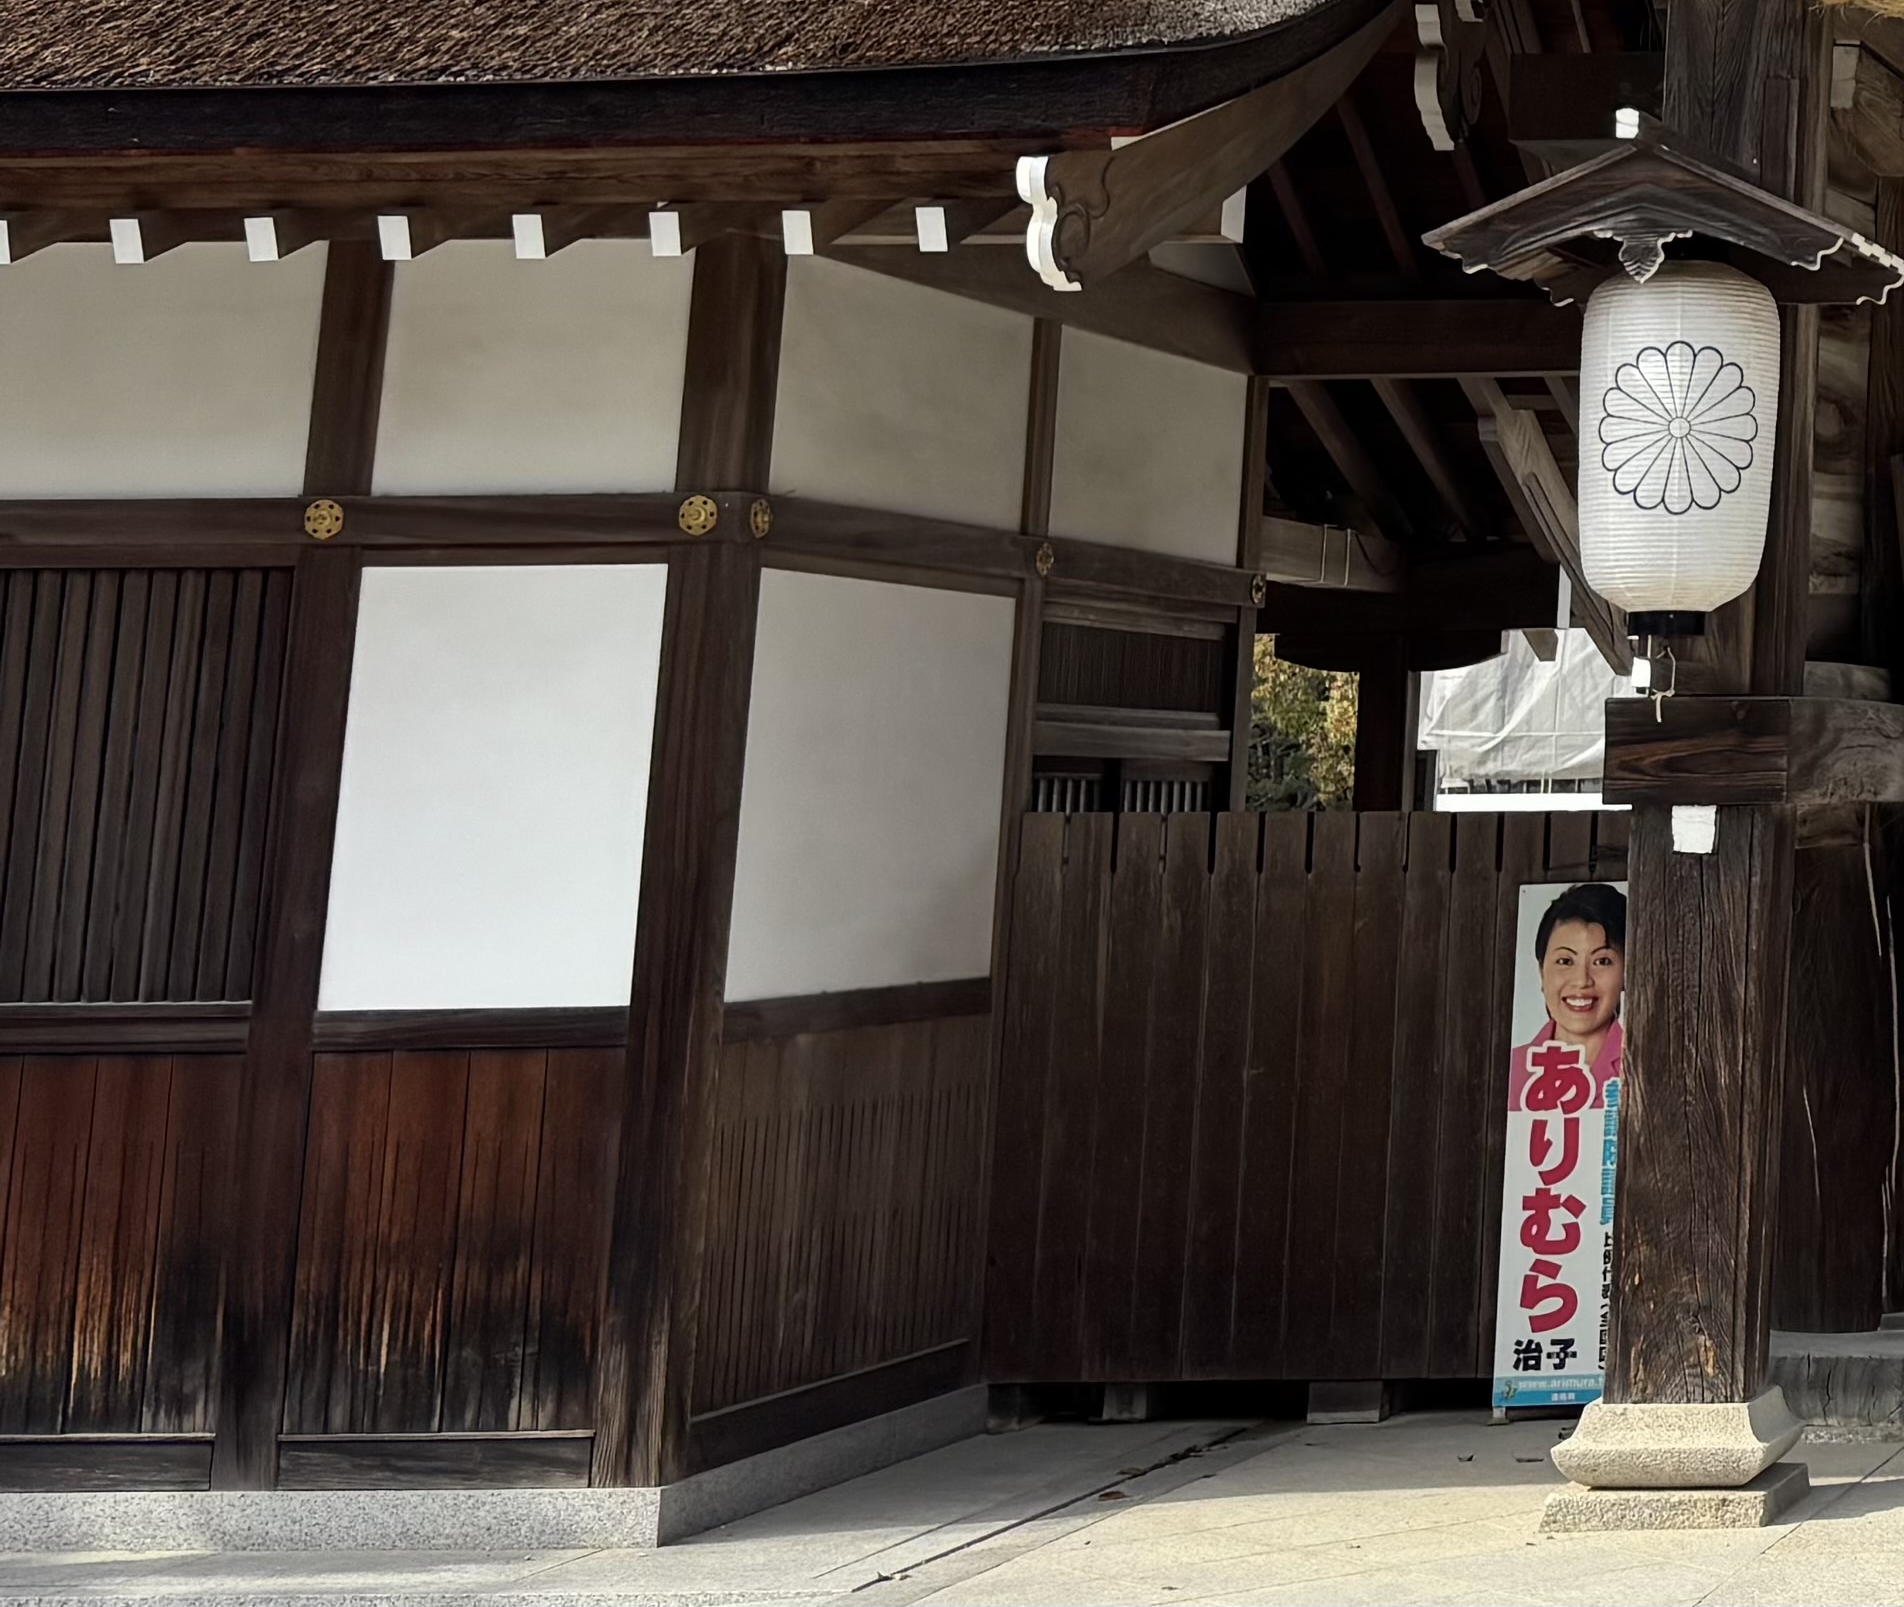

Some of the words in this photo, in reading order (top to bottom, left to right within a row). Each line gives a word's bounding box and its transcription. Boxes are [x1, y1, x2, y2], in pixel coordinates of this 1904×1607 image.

[1520, 1046, 1590, 1333] ありむら
[1513, 1338, 1577, 1371] 治子
